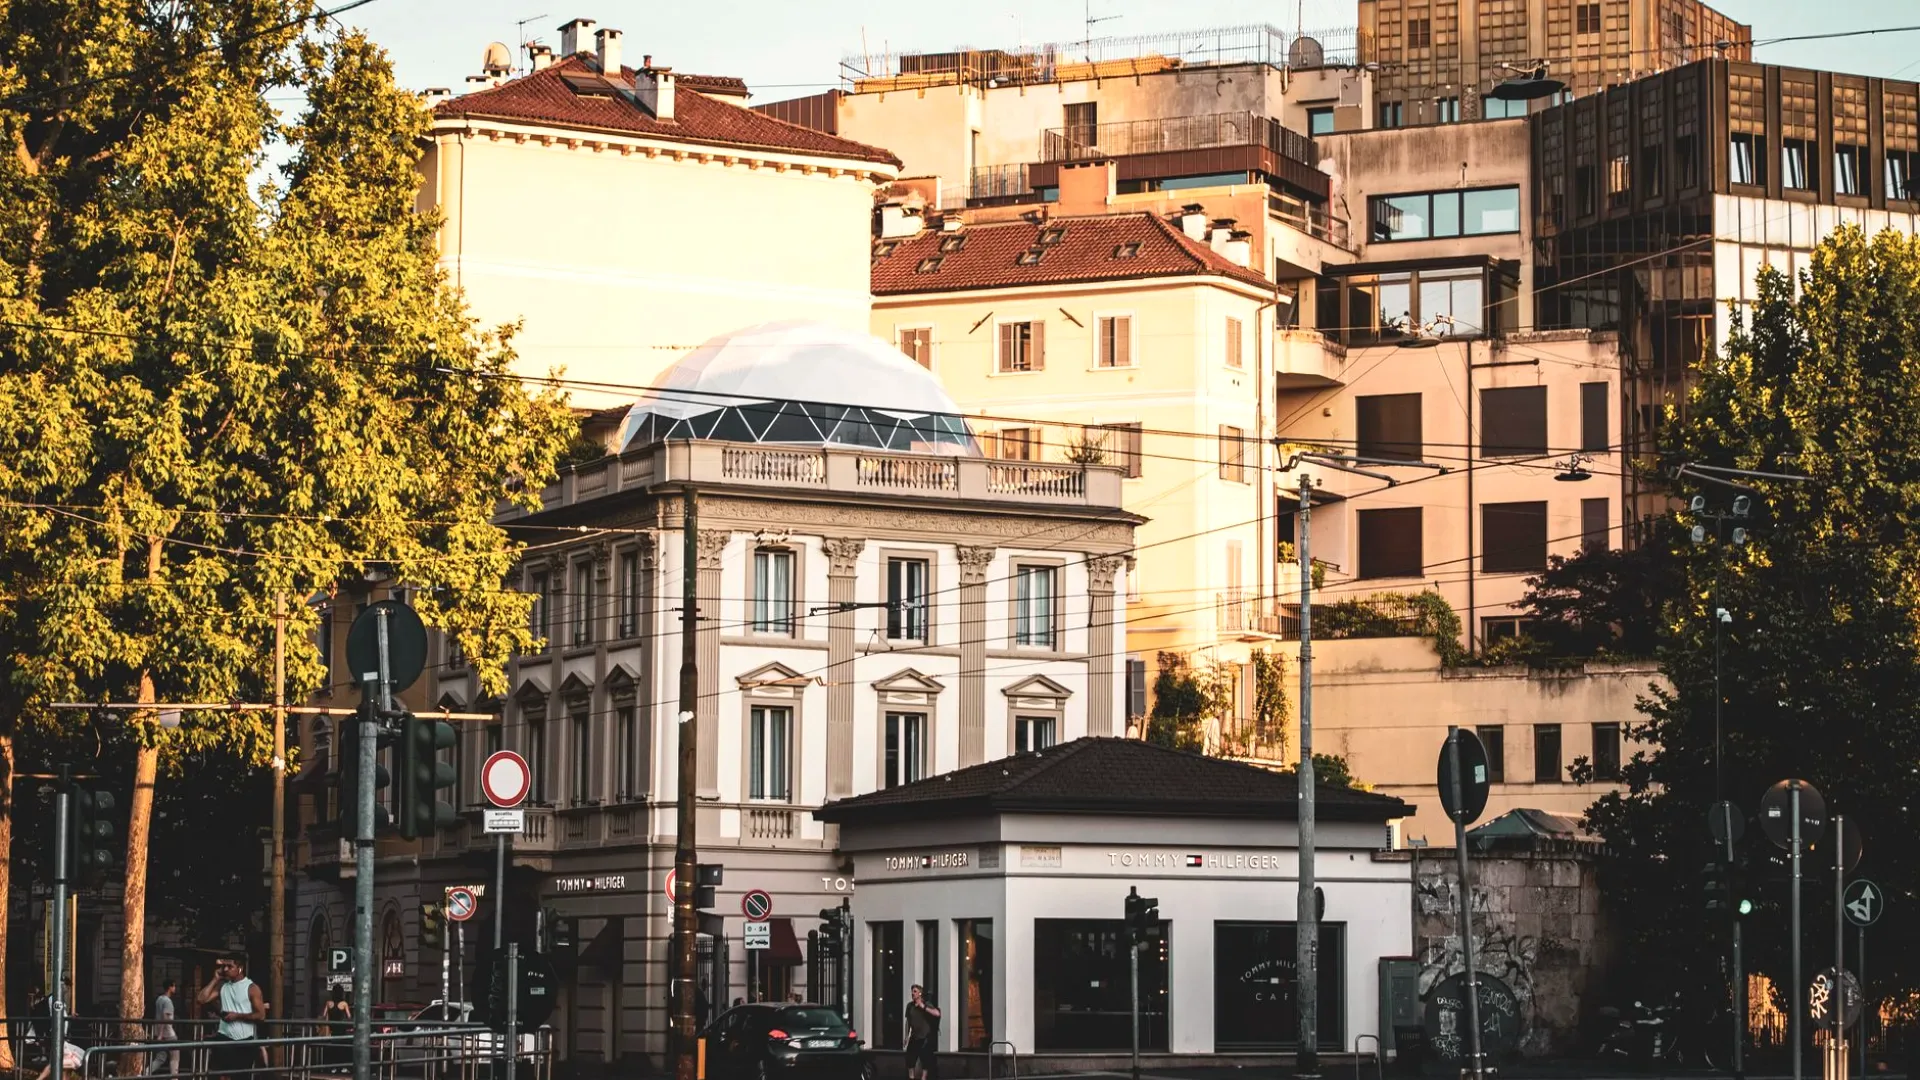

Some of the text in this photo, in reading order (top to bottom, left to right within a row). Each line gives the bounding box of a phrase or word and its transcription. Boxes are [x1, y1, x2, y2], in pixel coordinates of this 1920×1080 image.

[885, 853, 969, 870] TOMMY HILFIGER
[1108, 852, 1280, 870] TOMMY HILFIGER
[556, 876, 625, 891] TOMMY HILFIGER
[822, 877, 855, 891] TO
[332, 950, 347, 970] P
[1240, 960, 1297, 983] TOMMY HILF
[1255, 992, 1289, 1001] CAF
